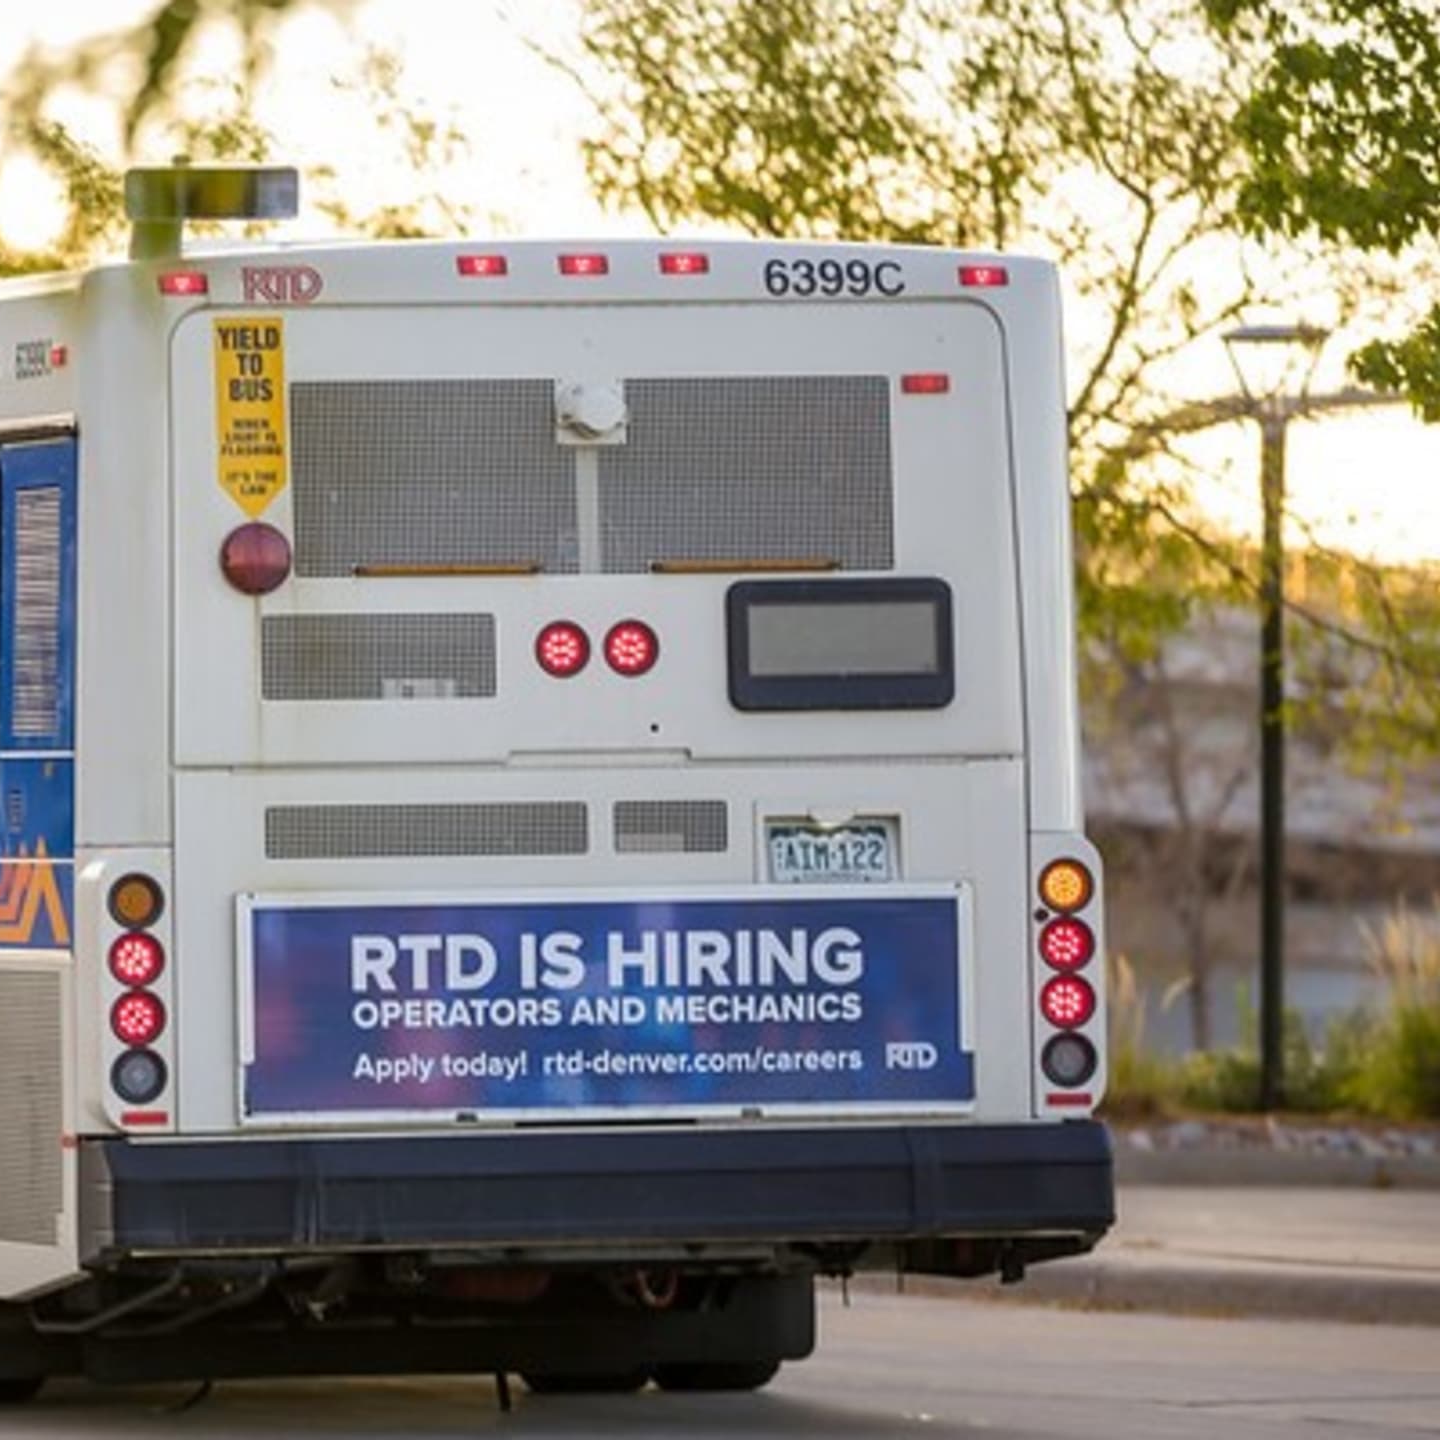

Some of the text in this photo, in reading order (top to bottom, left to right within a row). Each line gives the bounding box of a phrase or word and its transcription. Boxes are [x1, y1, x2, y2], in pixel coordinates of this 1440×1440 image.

[242, 265, 322, 302] RTD
[764, 259, 905, 296] 6399C
[217, 326, 281, 350] YIELD
[237, 353, 264, 376] TO
[229, 378, 273, 402] BUS
[351, 926, 864, 991] RTD IS HIRING
[352, 992, 863, 1030] OPERATORS AND MECHANICS
[353, 1046, 863, 1084] Apply today! rtd-denver.com/careers
[884, 1042, 939, 1070] RTD
